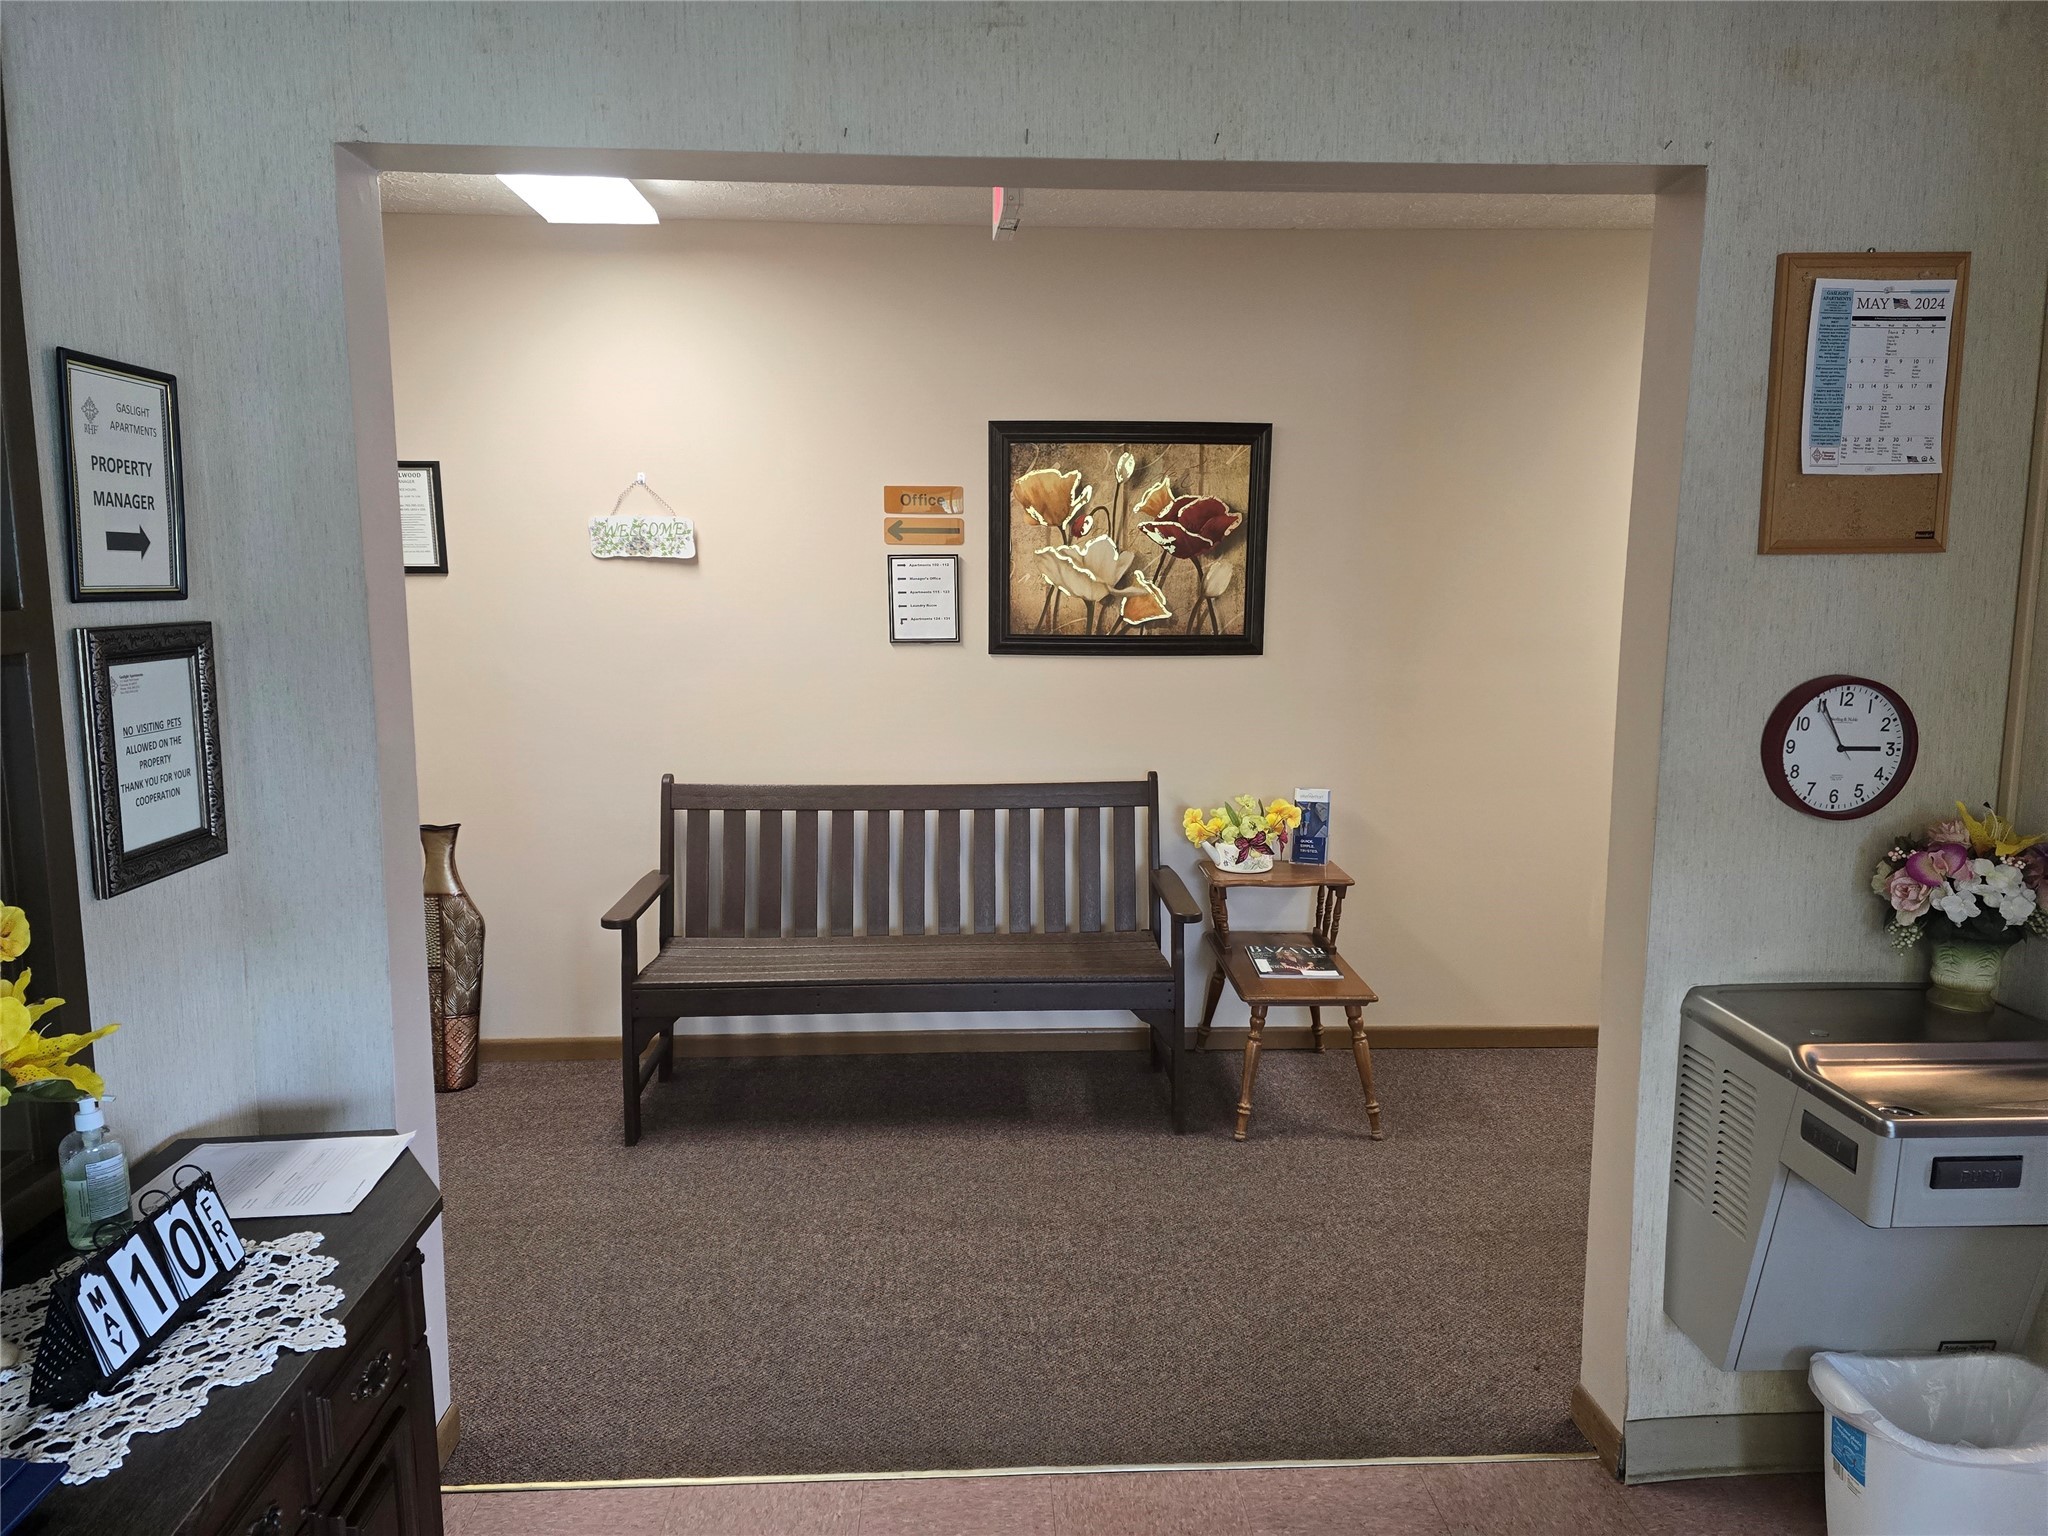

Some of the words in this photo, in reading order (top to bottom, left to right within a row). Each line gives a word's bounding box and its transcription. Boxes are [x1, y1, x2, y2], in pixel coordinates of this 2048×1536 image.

[1857, 297, 1890, 310] MAY
[1914, 297, 1946, 310] 2024
[116, 402, 150, 418] GASLIGHT
[110, 420, 157, 438] APARTMENTS
[90, 454, 152, 477] PROPERTY
[93, 490, 155, 511] MANAGER
[900, 493, 946, 506] Office
[602, 521, 685, 538] WELCOME
[1839, 692, 1855, 706] 12
[1868, 699, 1872, 714] 1
[122, 725, 134, 737] NO
[136, 720, 164, 735] VISITING
[166, 717, 182, 729] PETS
[1796, 716, 1810, 731] 10
[1880, 717, 1891, 732] 2
[125, 740, 157, 756] ALLOWED
[158, 738, 169, 749] ON
[170, 735, 182, 746] THE
[1786, 739, 1796, 754] 9
[1885, 742, 1895, 756] 3
[139, 754, 171, 770] PROPERTY
[1790, 764, 1800, 778] 8
[1874, 767, 1884, 781] 4
[120, 777, 144, 794] THANK
[144, 775, 159, 788] YOU
[160, 772, 173, 784] FOR
[174, 768, 191, 782] YOUR
[1807, 782, 1816, 796] 7
[1829, 789, 1839, 804] 6
[1854, 784, 1864, 798] 5
[135, 787, 181, 807] COOPERATION
[1248, 945, 1324, 954] BAZAAR
[90, 1286, 129, 1356] MAY
[200, 1196, 238, 1263] FRI
